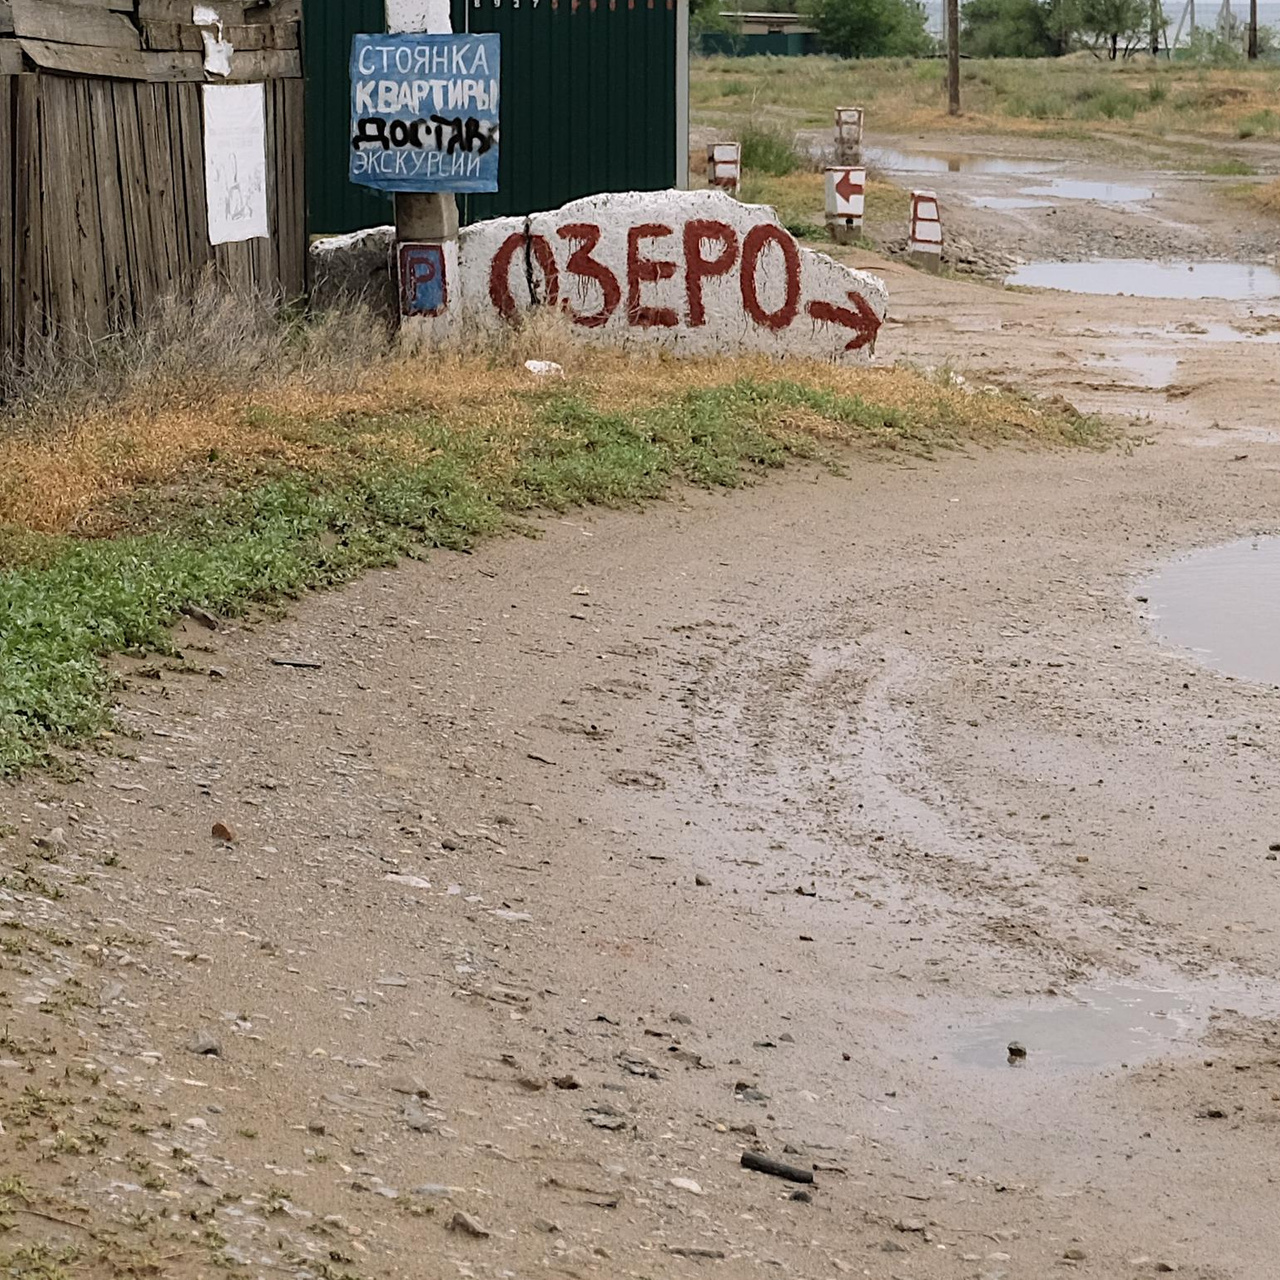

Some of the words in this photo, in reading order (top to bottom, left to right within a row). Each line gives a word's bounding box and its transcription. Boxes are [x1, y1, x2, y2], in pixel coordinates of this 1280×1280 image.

[358, 43, 490, 76] СТОЯНКА
[355, 78, 499, 116] КВАРТИРЫ
[353, 150, 481, 178] ЭКСКУРСИИ
[489, 219, 802, 331] ОЗЕРО
